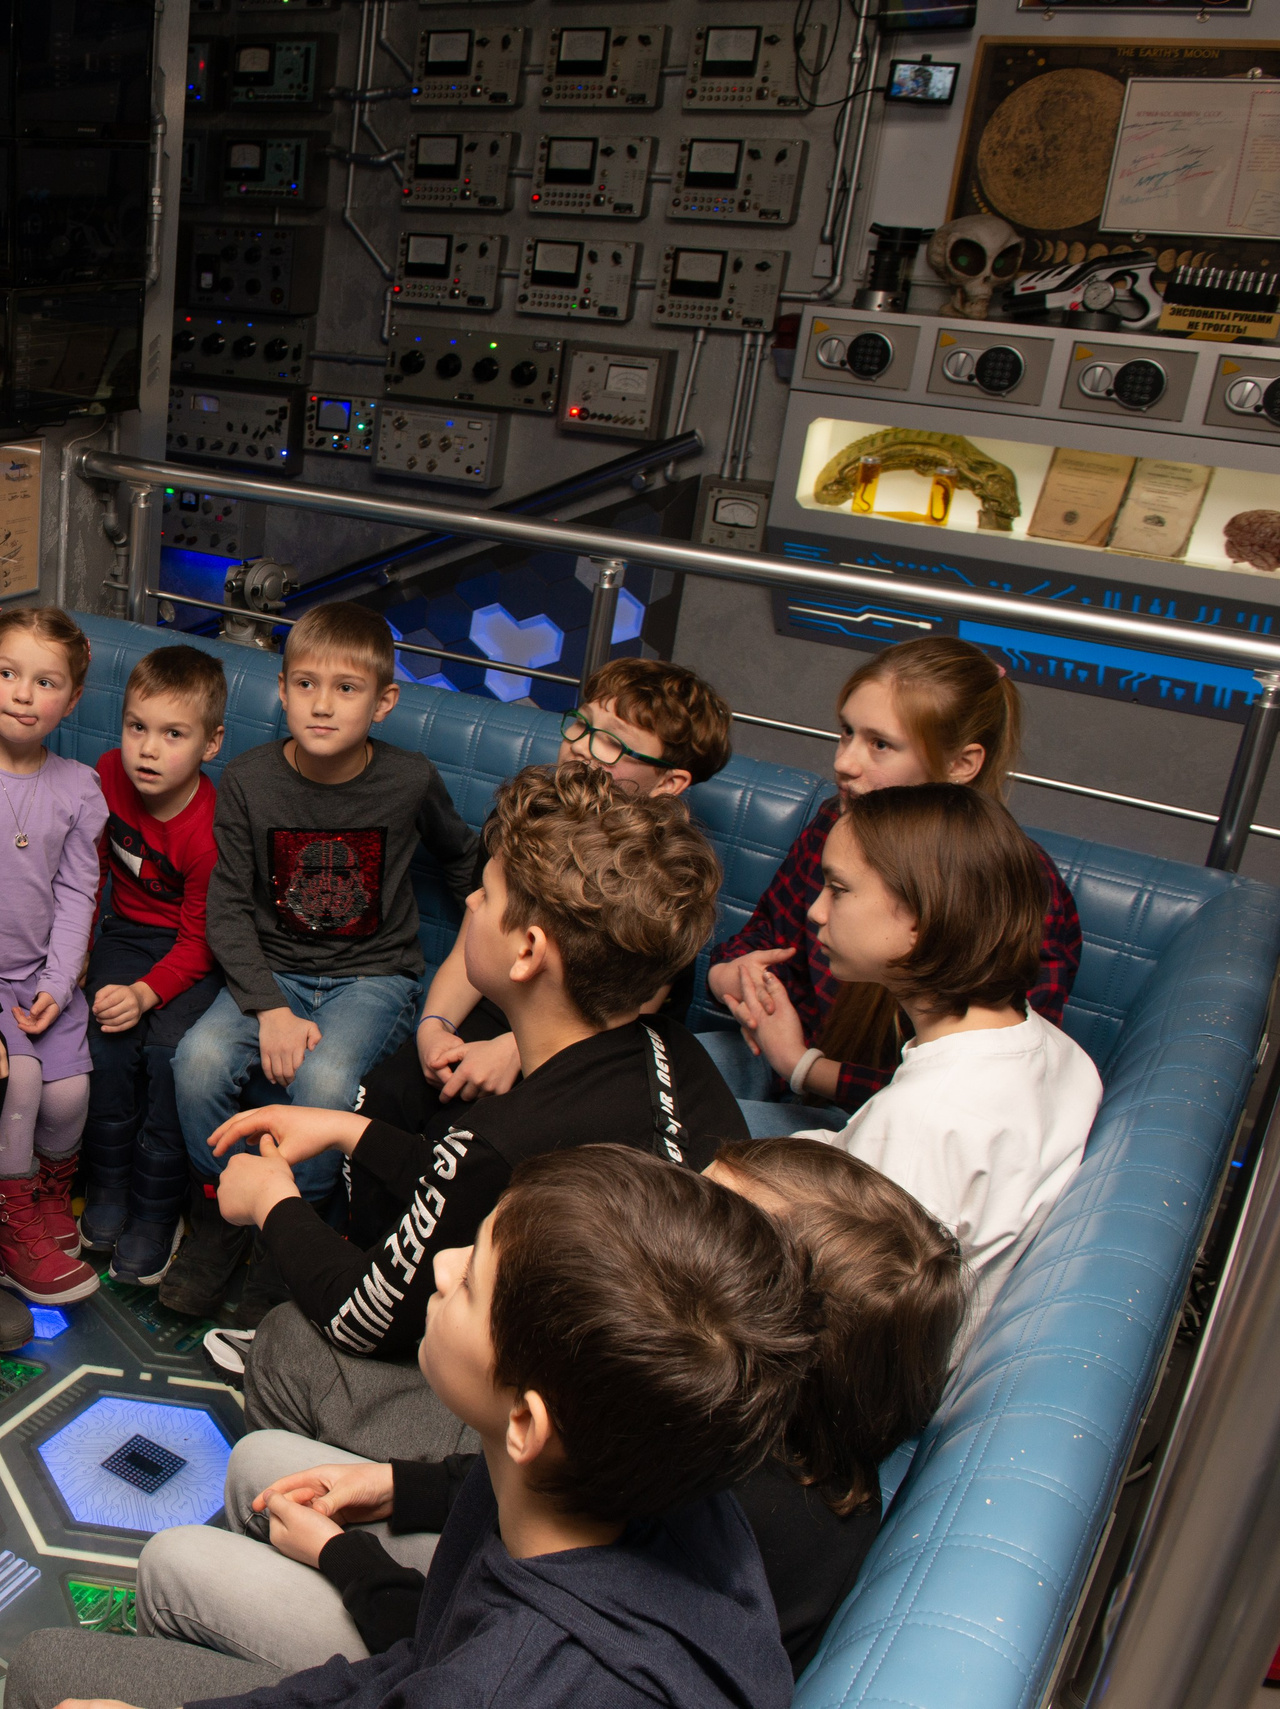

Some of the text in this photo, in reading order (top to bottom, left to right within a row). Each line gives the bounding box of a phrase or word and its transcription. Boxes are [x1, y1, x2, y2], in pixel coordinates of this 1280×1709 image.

[1117, 48, 1220, 58] THE EARTH'S MOON
[1168, 307, 1274, 325] ЭКСПОНАТЫ РУКАМИ
[1187, 321, 1248, 335] НЕ ТРОГАТЬ!
[384, 1175, 446, 1284] FREE
